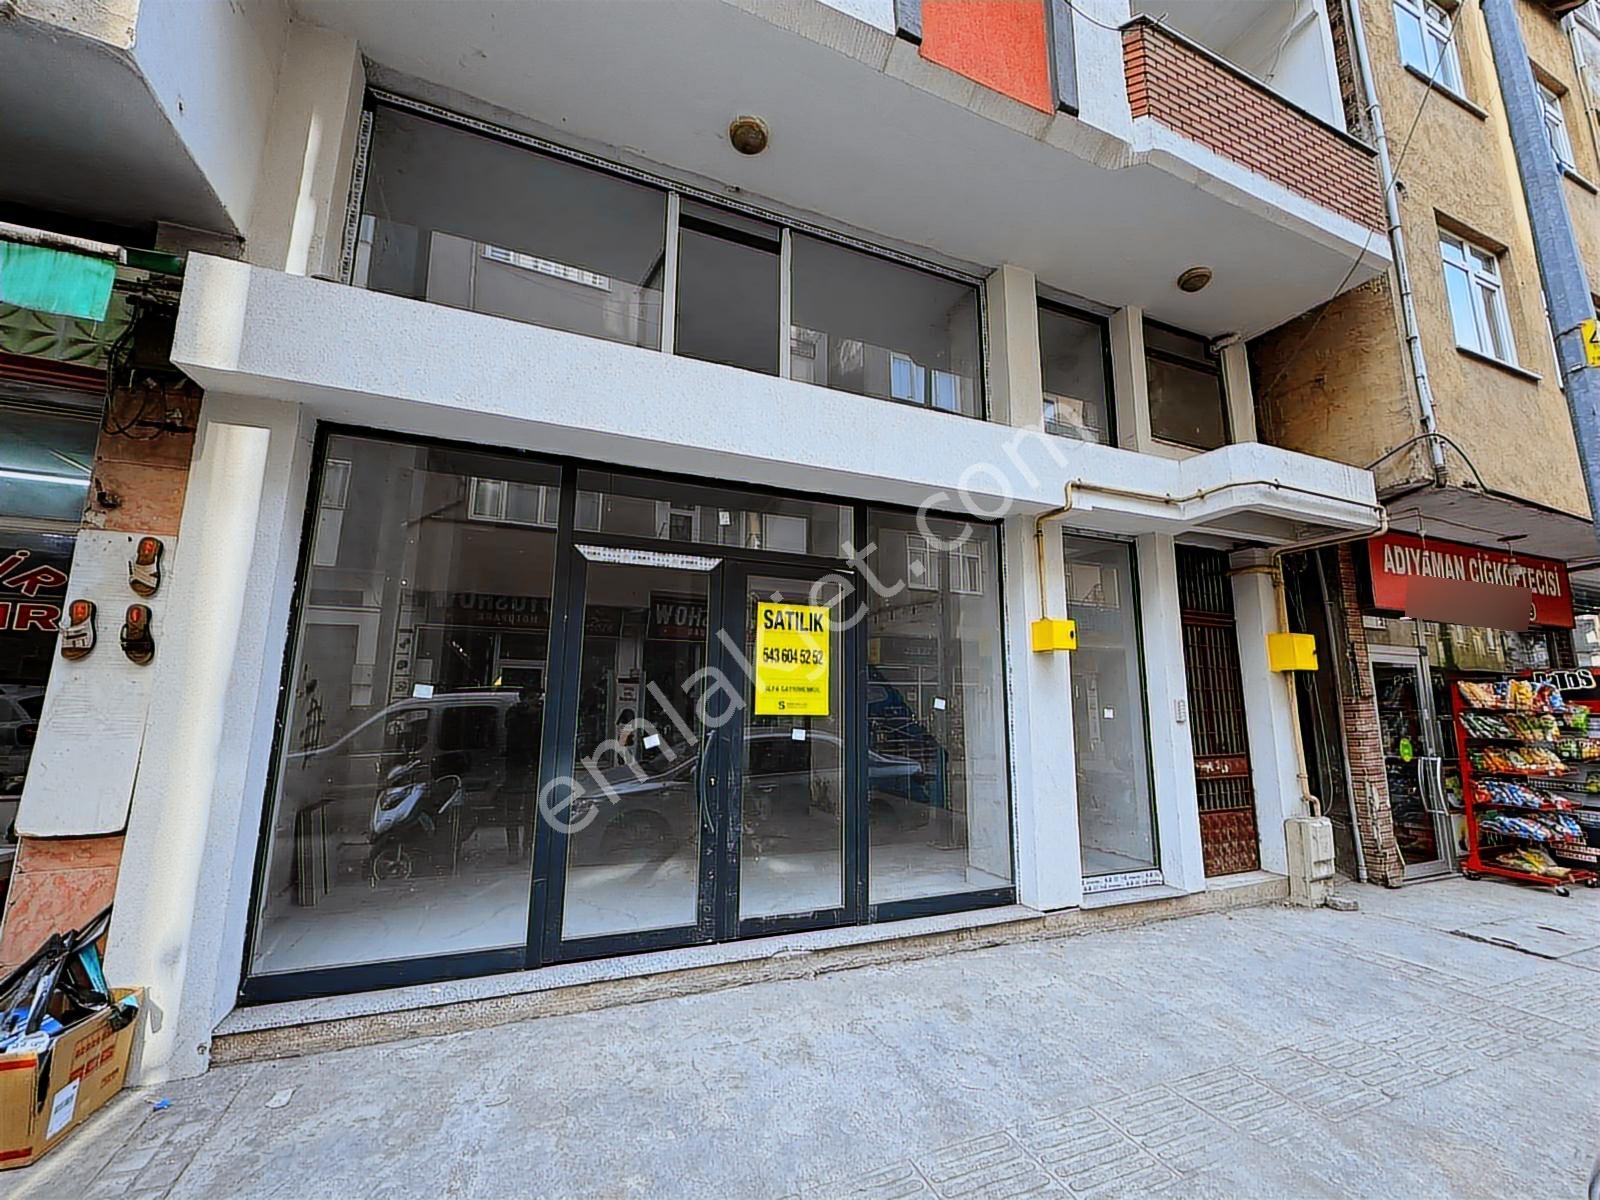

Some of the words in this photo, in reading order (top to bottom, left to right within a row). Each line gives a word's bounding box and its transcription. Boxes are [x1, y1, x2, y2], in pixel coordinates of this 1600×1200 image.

[1383, 543, 1466, 581] ADIYAMAN
[763, 609, 824, 632] SATILIK
[763, 647, 780, 663] 543
[781, 648, 798, 664] 604
[800, 649, 811, 665] 52
[812, 649, 823, 665] 52
